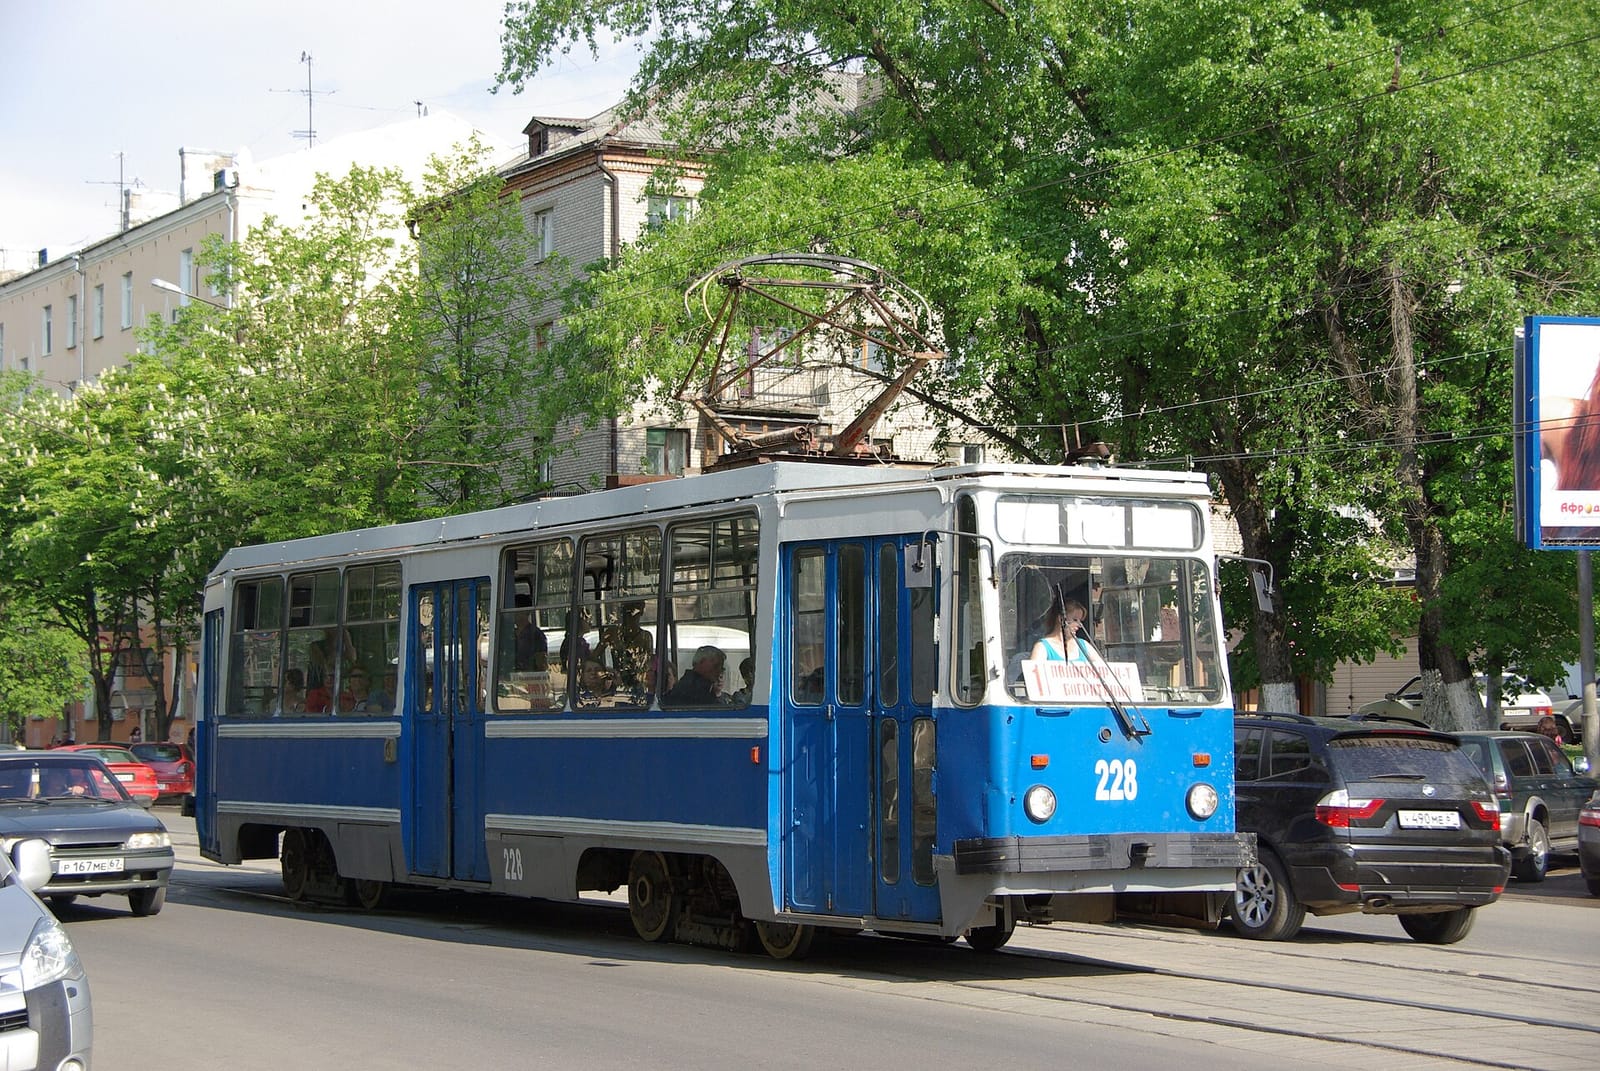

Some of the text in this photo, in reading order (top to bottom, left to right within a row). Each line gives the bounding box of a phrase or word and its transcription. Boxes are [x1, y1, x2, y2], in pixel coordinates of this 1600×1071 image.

[1032, 664, 1043, 696] 1
[1095, 759, 1138, 800] 228
[109, 859, 121, 867] 67
[504, 848, 523, 880] 228
